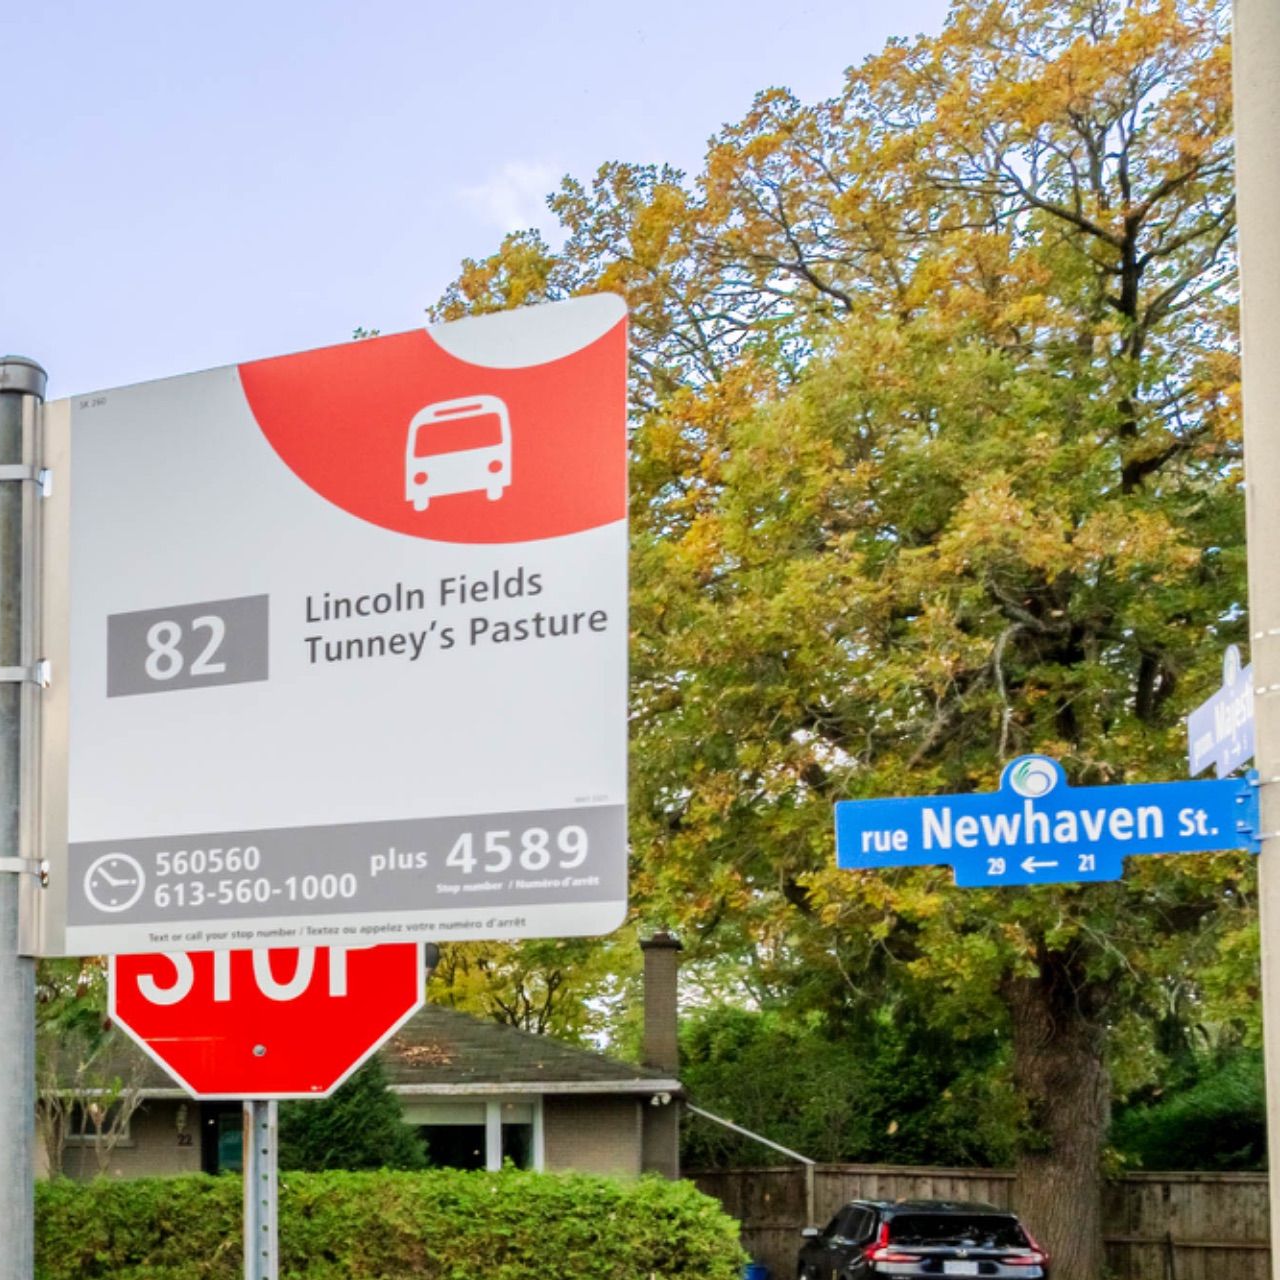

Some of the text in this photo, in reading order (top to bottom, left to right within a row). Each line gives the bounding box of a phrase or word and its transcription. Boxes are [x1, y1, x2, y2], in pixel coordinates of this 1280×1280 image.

[305, 566, 543, 624] Lincoln Fields
[144, 614, 227, 681] 82
[304, 607, 609, 665] Tunney's Pasture
[861, 799, 1220, 854] rue Newhaven St.
[155, 846, 262, 877] 560560
[369, 825, 590, 876] plus 4589
[986, 853, 1096, 876] 29 21
[154, 873, 358, 909] 613-560-1000
[436, 883, 461, 895] Stop
[462, 881, 504, 892] number
[148, 932, 170, 943] Text
[171, 934, 182, 942] or
[185, 931, 203, 941] call
[206, 932, 228, 944] your
[231, 930, 255, 941] stop
[256, 927, 296, 938] number
[306, 925, 340, 936] Textez
[342, 926, 357, 935] ou
[359, 923, 402, 936] appelez
[405, 922, 435, 932] votre
[439, 919, 483, 930] numéro
